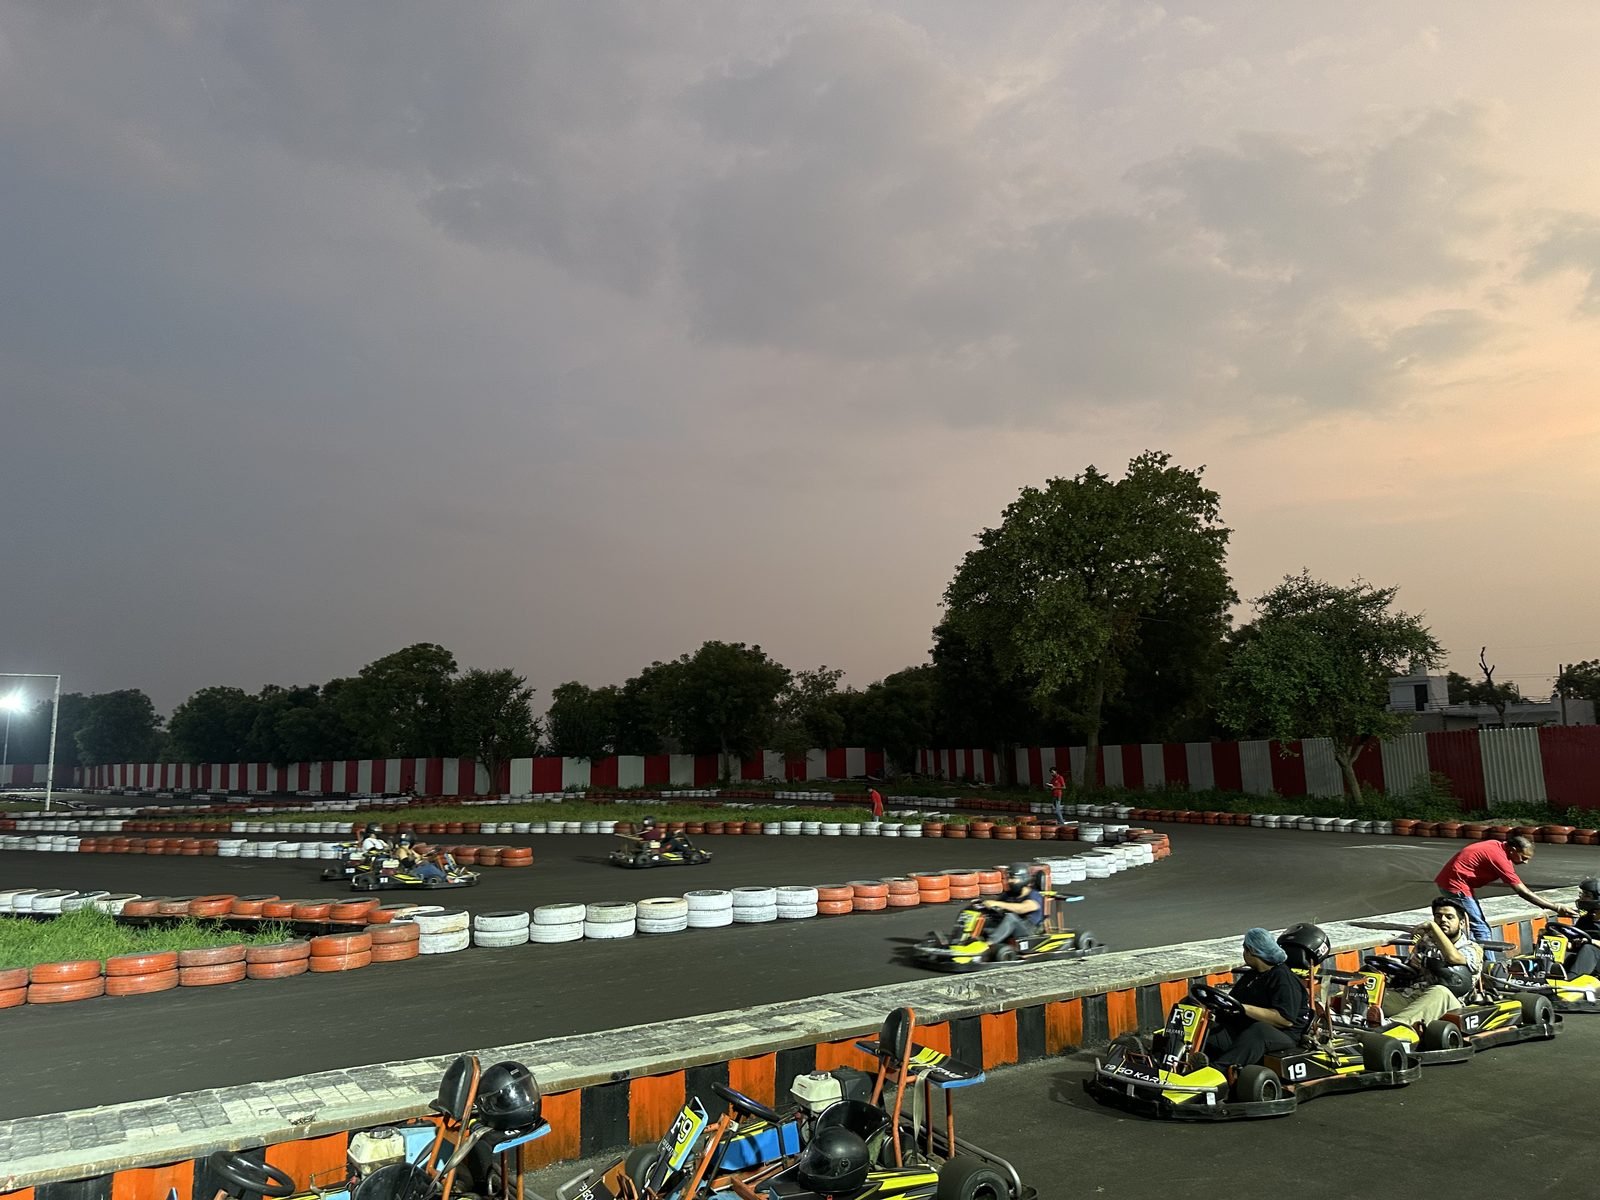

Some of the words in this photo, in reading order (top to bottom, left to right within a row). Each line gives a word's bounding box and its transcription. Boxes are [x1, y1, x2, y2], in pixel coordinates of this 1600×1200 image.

[1539, 938, 1561, 952] F9
[1171, 1008, 1194, 1026] F9
[1465, 1015, 1479, 1030] 12
[1117, 1066, 1133, 1075] GO
[1287, 1063, 1307, 1080] 19
[671, 1111, 692, 1143] F9
